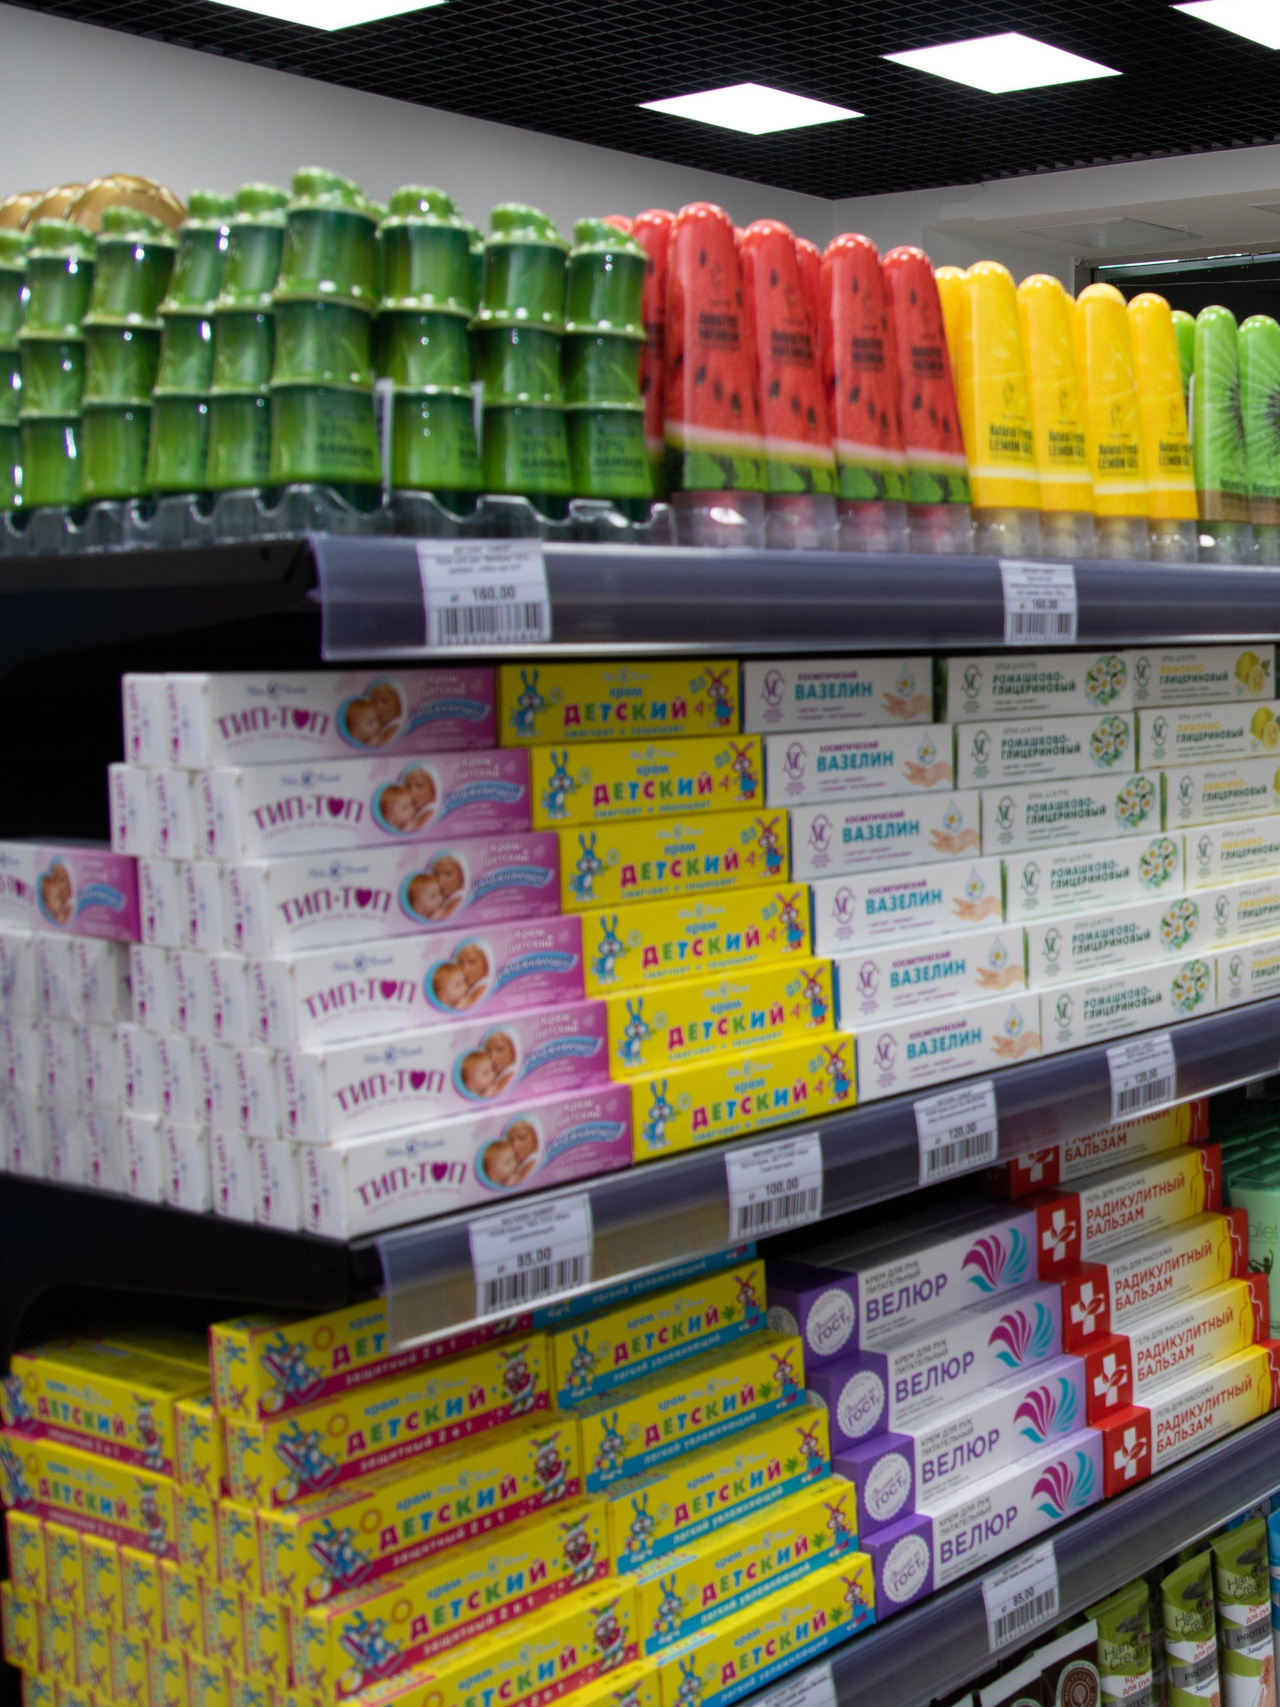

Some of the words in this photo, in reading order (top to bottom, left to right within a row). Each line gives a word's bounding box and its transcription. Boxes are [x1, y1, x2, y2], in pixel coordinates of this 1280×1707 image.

[562, 695, 688, 728] ДЕТСКИЙ
[794, 682, 873, 701] ВАЗЕЛИН
[816, 752, 894, 773] ВАЗЕЛИН
[593, 770, 713, 807] ДЕТСКИЙ
[842, 821, 920, 844] ВАЗЕЛИН
[620, 847, 739, 888] ДЕТСКИЙ
[865, 889, 942, 915] ВАЗЕЛИН
[641, 924, 760, 970] ДЕТСКИЙ
[889, 959, 966, 989] ВАЗЕЛИН
[667, 1002, 784, 1051] ДЕТСКИЙ
[906, 1029, 982, 1060] ВАЗЕЛИН
[691, 1078, 808, 1131] ДЕТСКИЙ
[1065, 1133, 1127, 1163] БАЛЬЗАМ
[1086, 1172, 1185, 1223] РАДИКУЛИТНЫЙ
[1086, 1207, 1144, 1240] БАЛЬЗАМ
[864, 1271, 886, 1286] КРЕМ
[904, 1261, 919, 1274] РУК
[1115, 1240, 1213, 1294] РАДИКУЛИТНЫЙ
[866, 1273, 948, 1323] ВЕЛЮР
[1115, 1276, 1173, 1312] БАЛЬЗАМ
[1137, 1306, 1233, 1366] РАДИКУЛИТНЫЙ
[894, 1351, 975, 1404] ВЕЛЮР
[1137, 1344, 1195, 1382] БАЛЬЗАМ
[347, 1383, 486, 1456] ДЕТСКИЙ
[644, 1382, 755, 1447] ДЕТСКИЙ
[1156, 1375, 1252, 1437] РАДИКУЛИТНЫЙ
[920, 1432, 941, 1448] КРЕМ
[958, 1418, 972, 1433] РУК
[921, 1429, 1000, 1485] ВЕЛЮР
[1156, 1413, 1213, 1454] БАЛЬЗАМ
[378, 1473, 517, 1552] ДЕТСКИЙ
[673, 1458, 782, 1527] ДЕТСКИЙ
[940, 1506, 1018, 1564] ВЕЛЮР
[701, 1534, 808, 1607] ДЕТСКИЙ
[410, 1557, 547, 1642] ДЕТСКИЙ
[721, 1608, 826, 1686] ДЕТСКИЙ
[463, 1644, 577, 1707] ЕТСКИЙ
